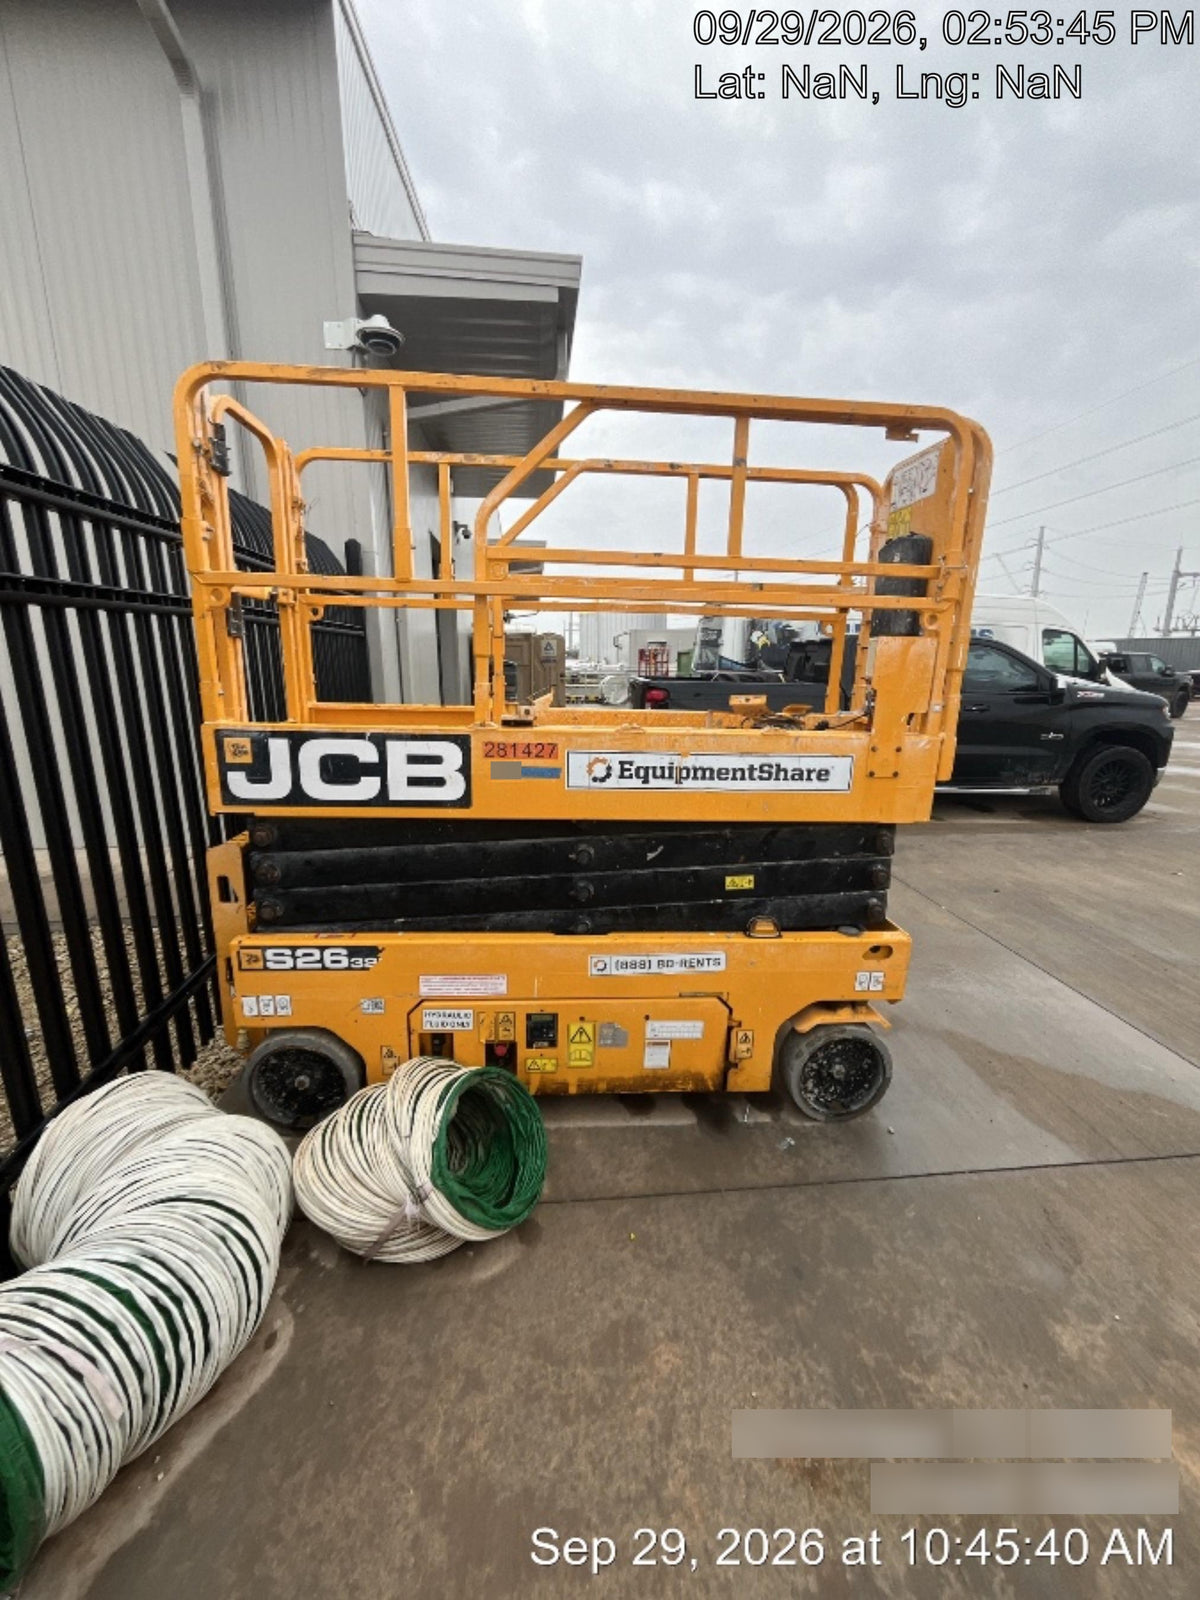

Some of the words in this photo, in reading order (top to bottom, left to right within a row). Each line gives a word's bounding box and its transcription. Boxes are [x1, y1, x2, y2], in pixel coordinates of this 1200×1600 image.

[484, 742, 557, 759] 281427
[227, 738, 466, 800] JCB
[618, 760, 831, 784] EquipmentShare
